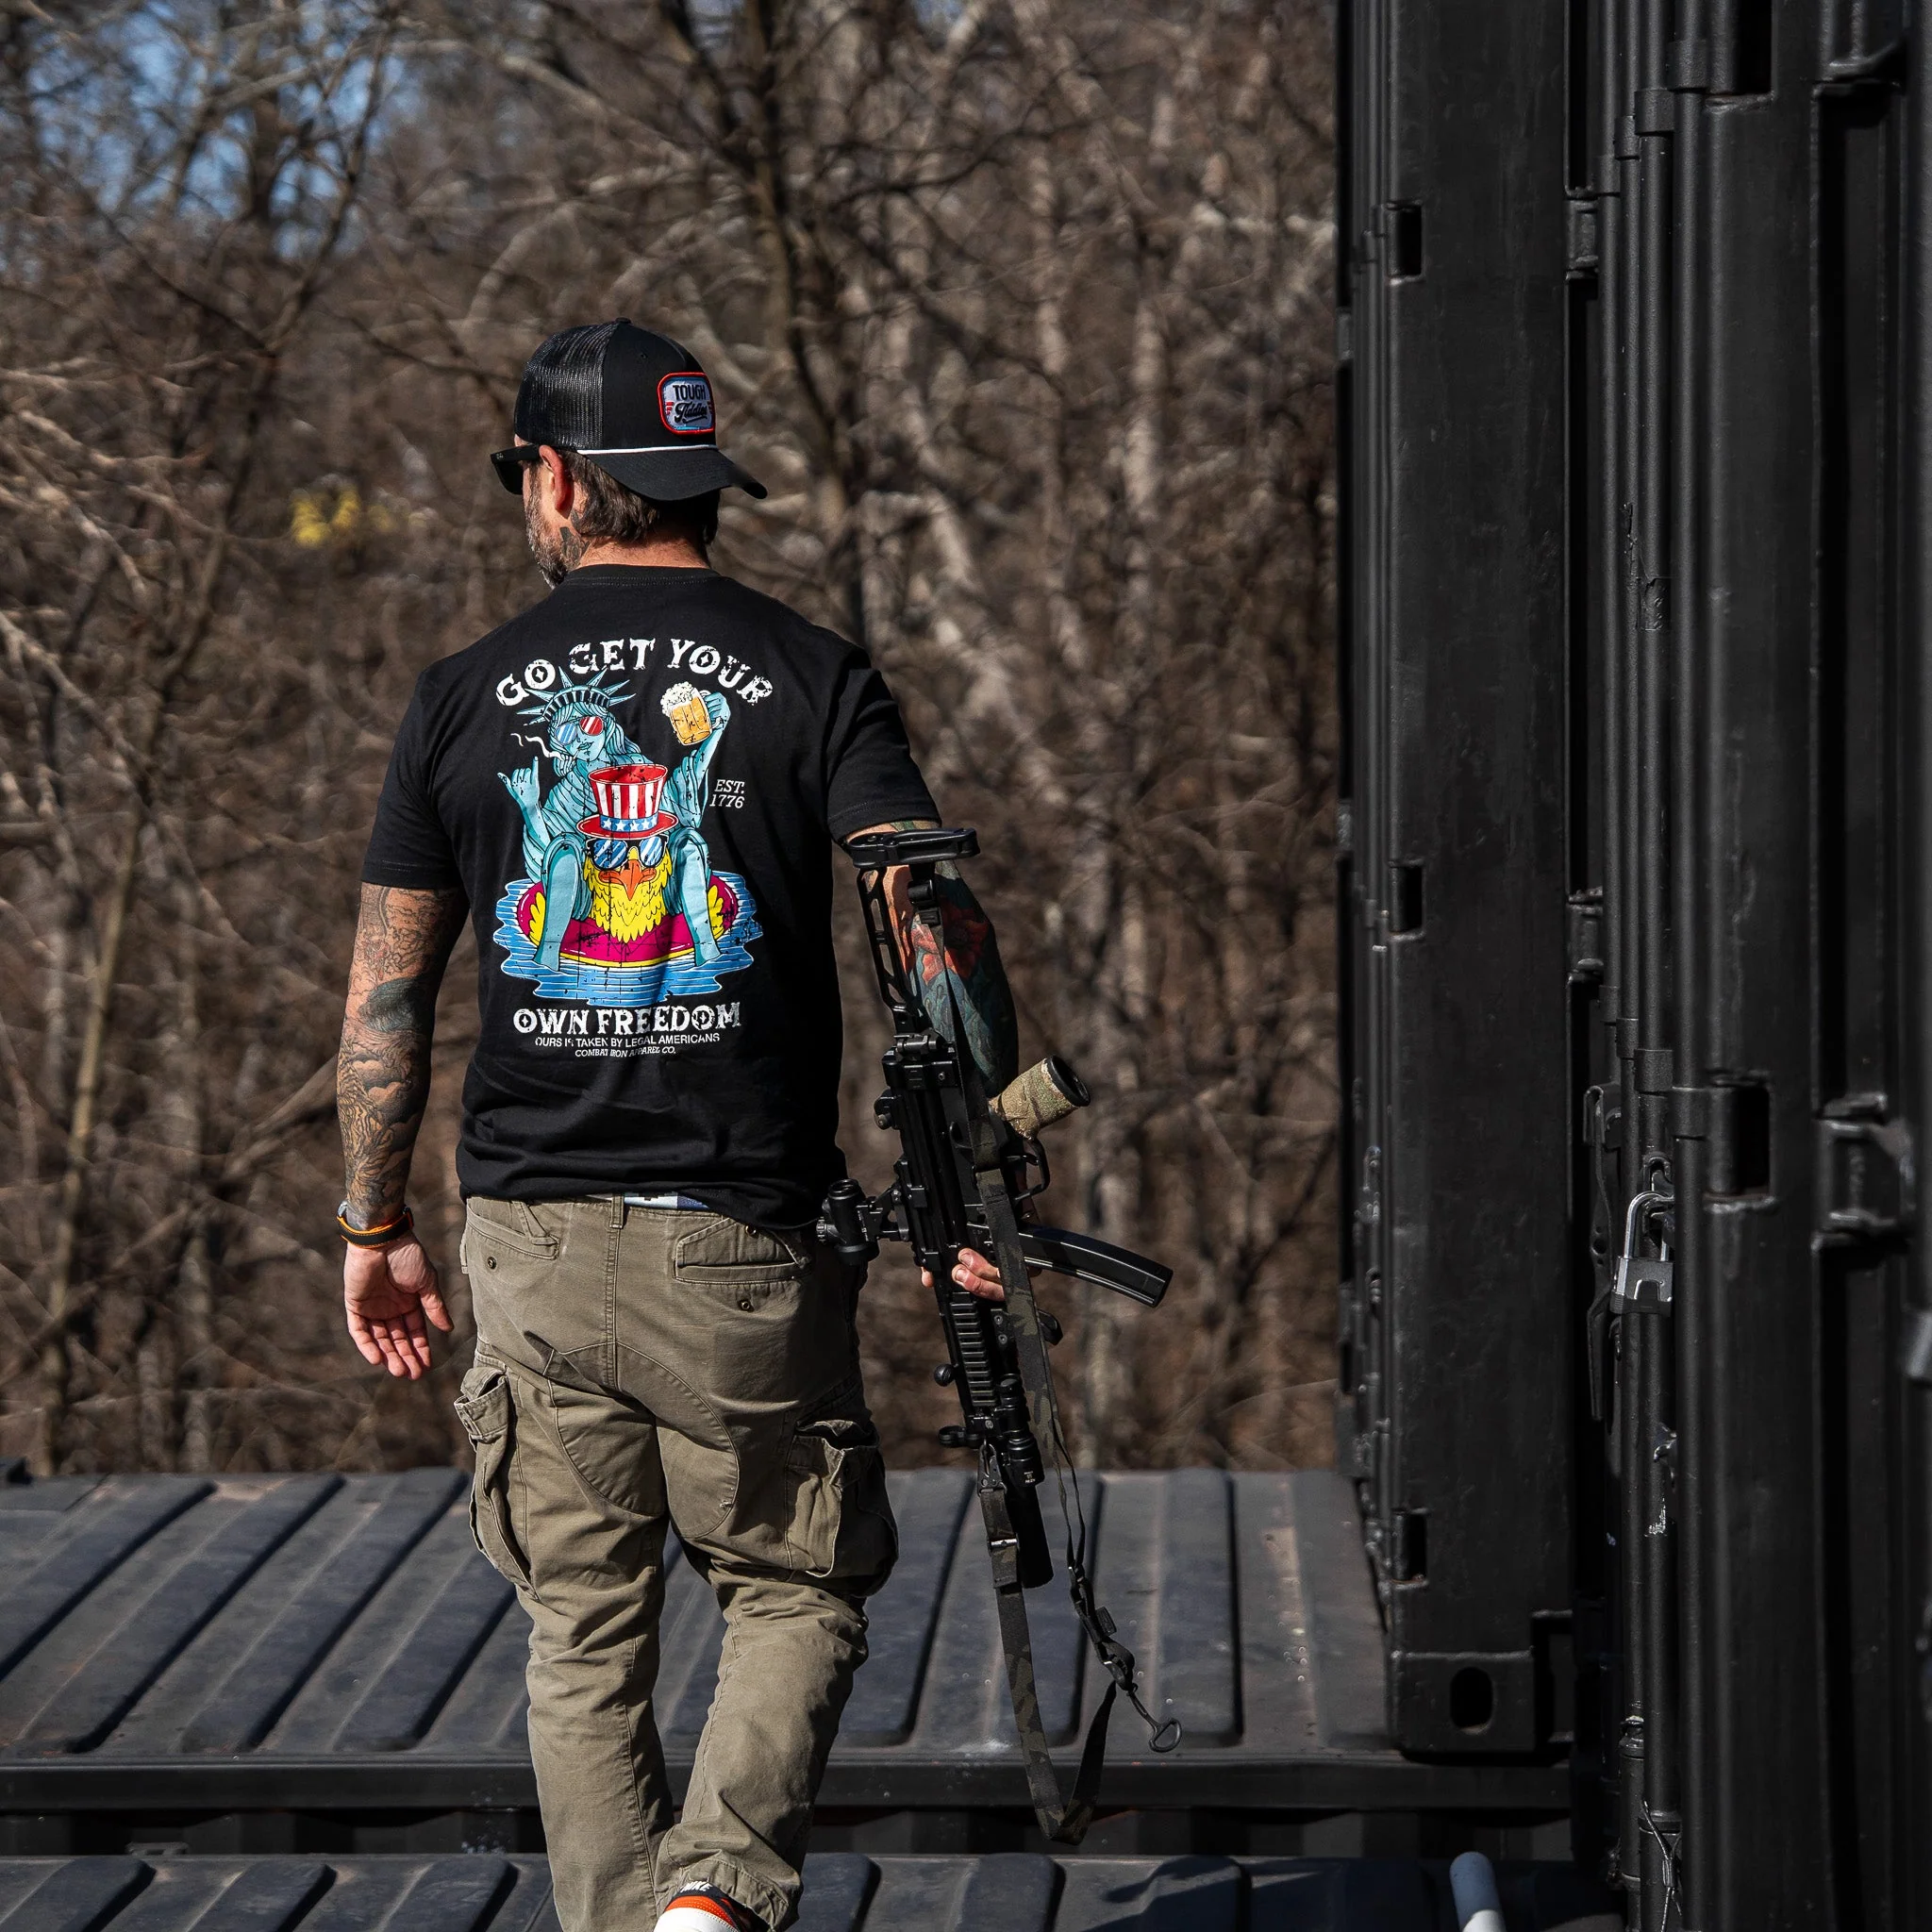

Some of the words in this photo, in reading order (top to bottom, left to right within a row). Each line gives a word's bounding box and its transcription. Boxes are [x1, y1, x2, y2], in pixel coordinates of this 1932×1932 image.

[673, 385, 707, 401] TOUGH
[496, 658, 556, 707] GO
[568, 638, 657, 675] GET
[666, 638, 774, 706] YOUR
[714, 778, 745, 794] EST.
[709, 793, 745, 808] 1776
[513, 1008, 590, 1035] OWN
[596, 1001, 741, 1036] FREEDOM
[535, 1037, 563, 1047] OURS
[575, 1038, 608, 1048] TAKEN
[610, 1038, 623, 1048] BY
[625, 1035, 657, 1048] LEGAL
[658, 1032, 721, 1045] AMERICANS
[575, 1048, 608, 1058] COMBAT
[661, 1045, 676, 1055] CO.
